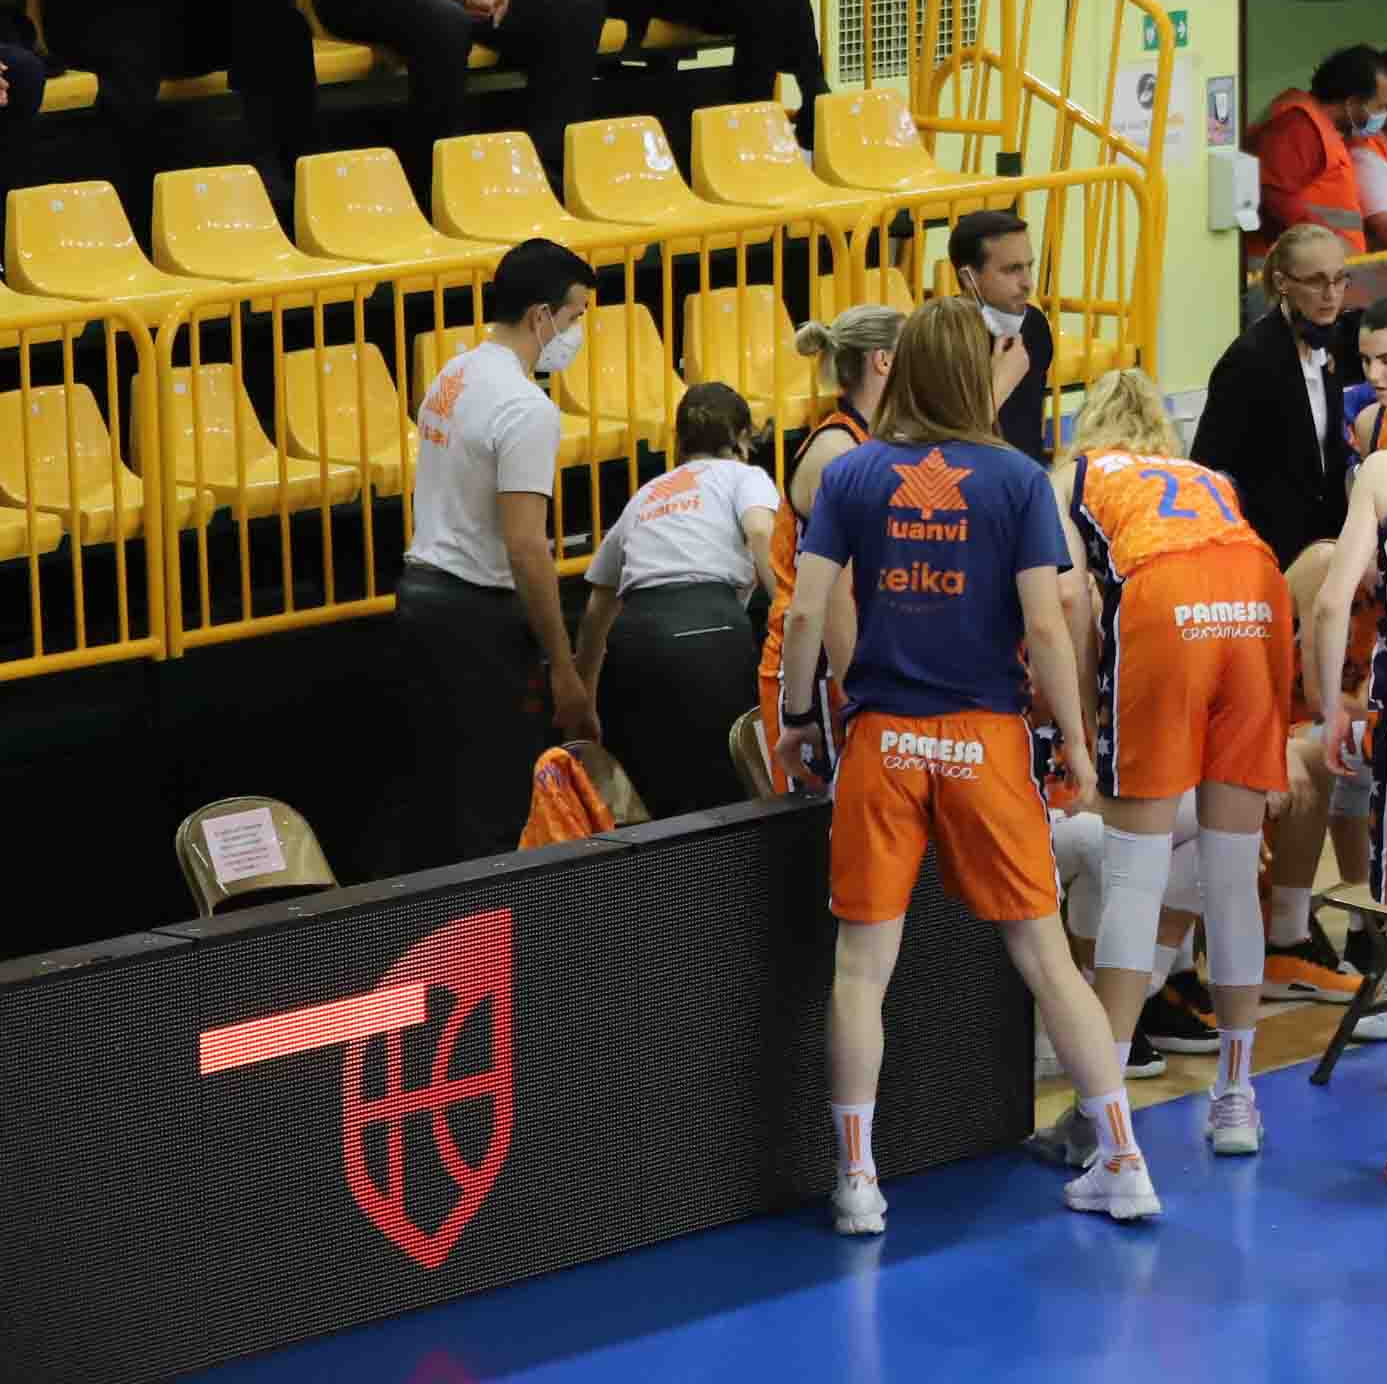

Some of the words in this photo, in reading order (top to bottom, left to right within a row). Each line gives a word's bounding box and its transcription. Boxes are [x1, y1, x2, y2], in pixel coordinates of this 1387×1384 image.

[1139, 468, 1239, 523] 21
[1174, 601, 1273, 627] PAMESA
[880, 731, 984, 765] PAMESA
